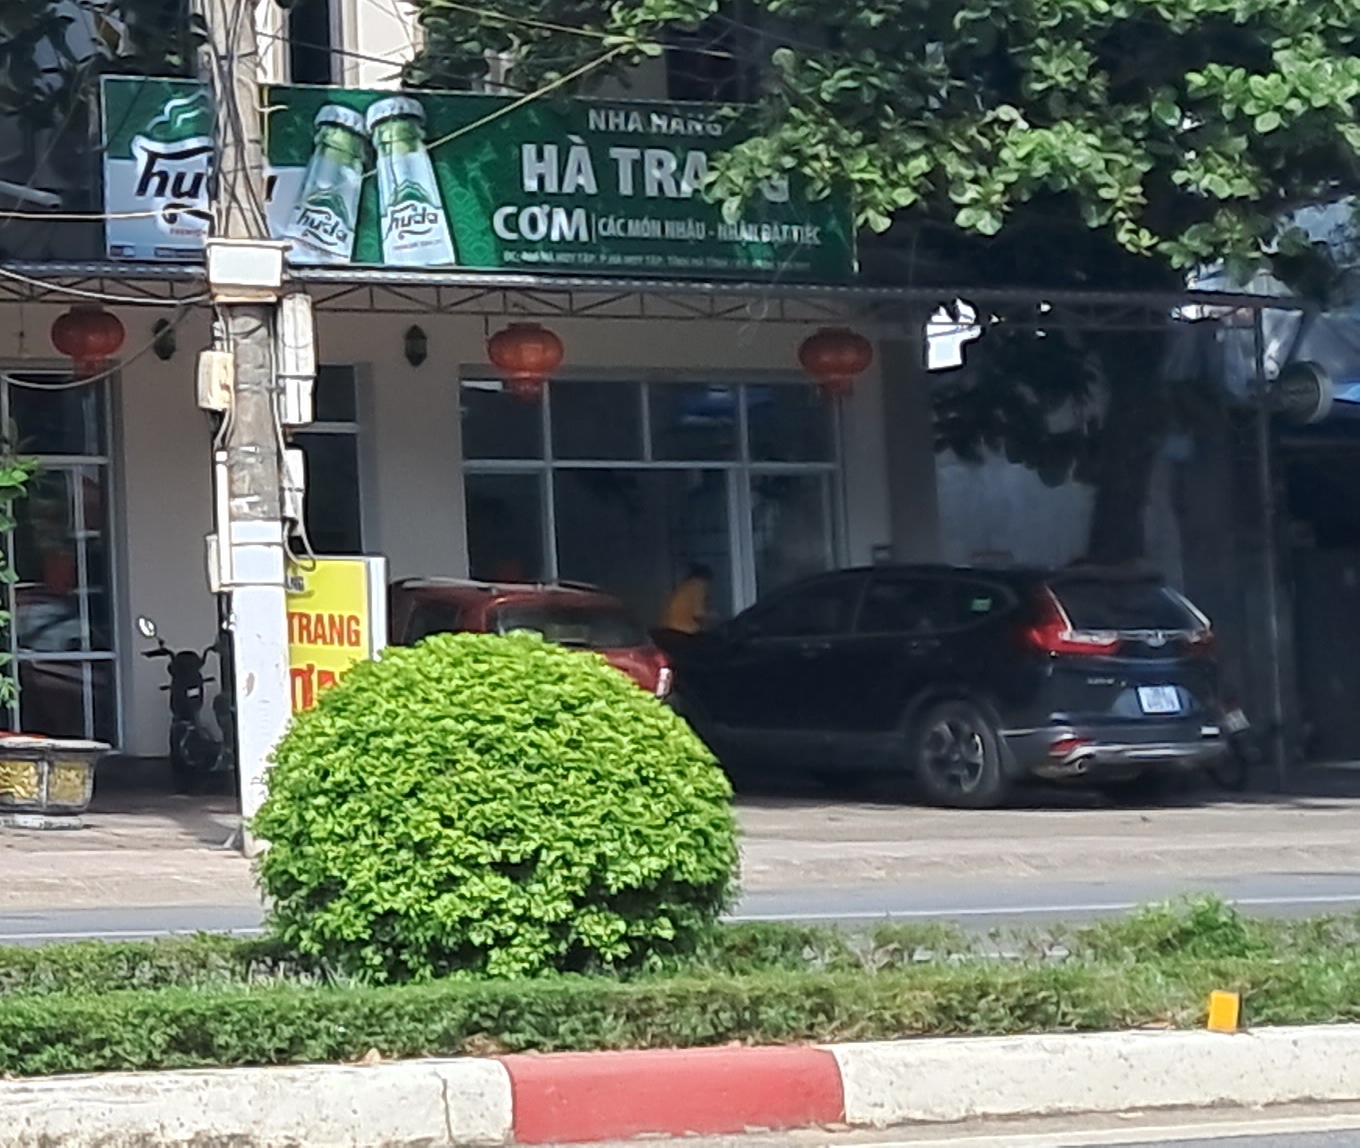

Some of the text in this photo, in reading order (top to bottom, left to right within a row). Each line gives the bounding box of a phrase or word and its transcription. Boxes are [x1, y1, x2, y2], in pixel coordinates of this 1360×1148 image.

[521, 134, 789, 203] HÀ TRA
[492, 203, 590, 243] CƠM
[288, 612, 361, 647] TRANG
